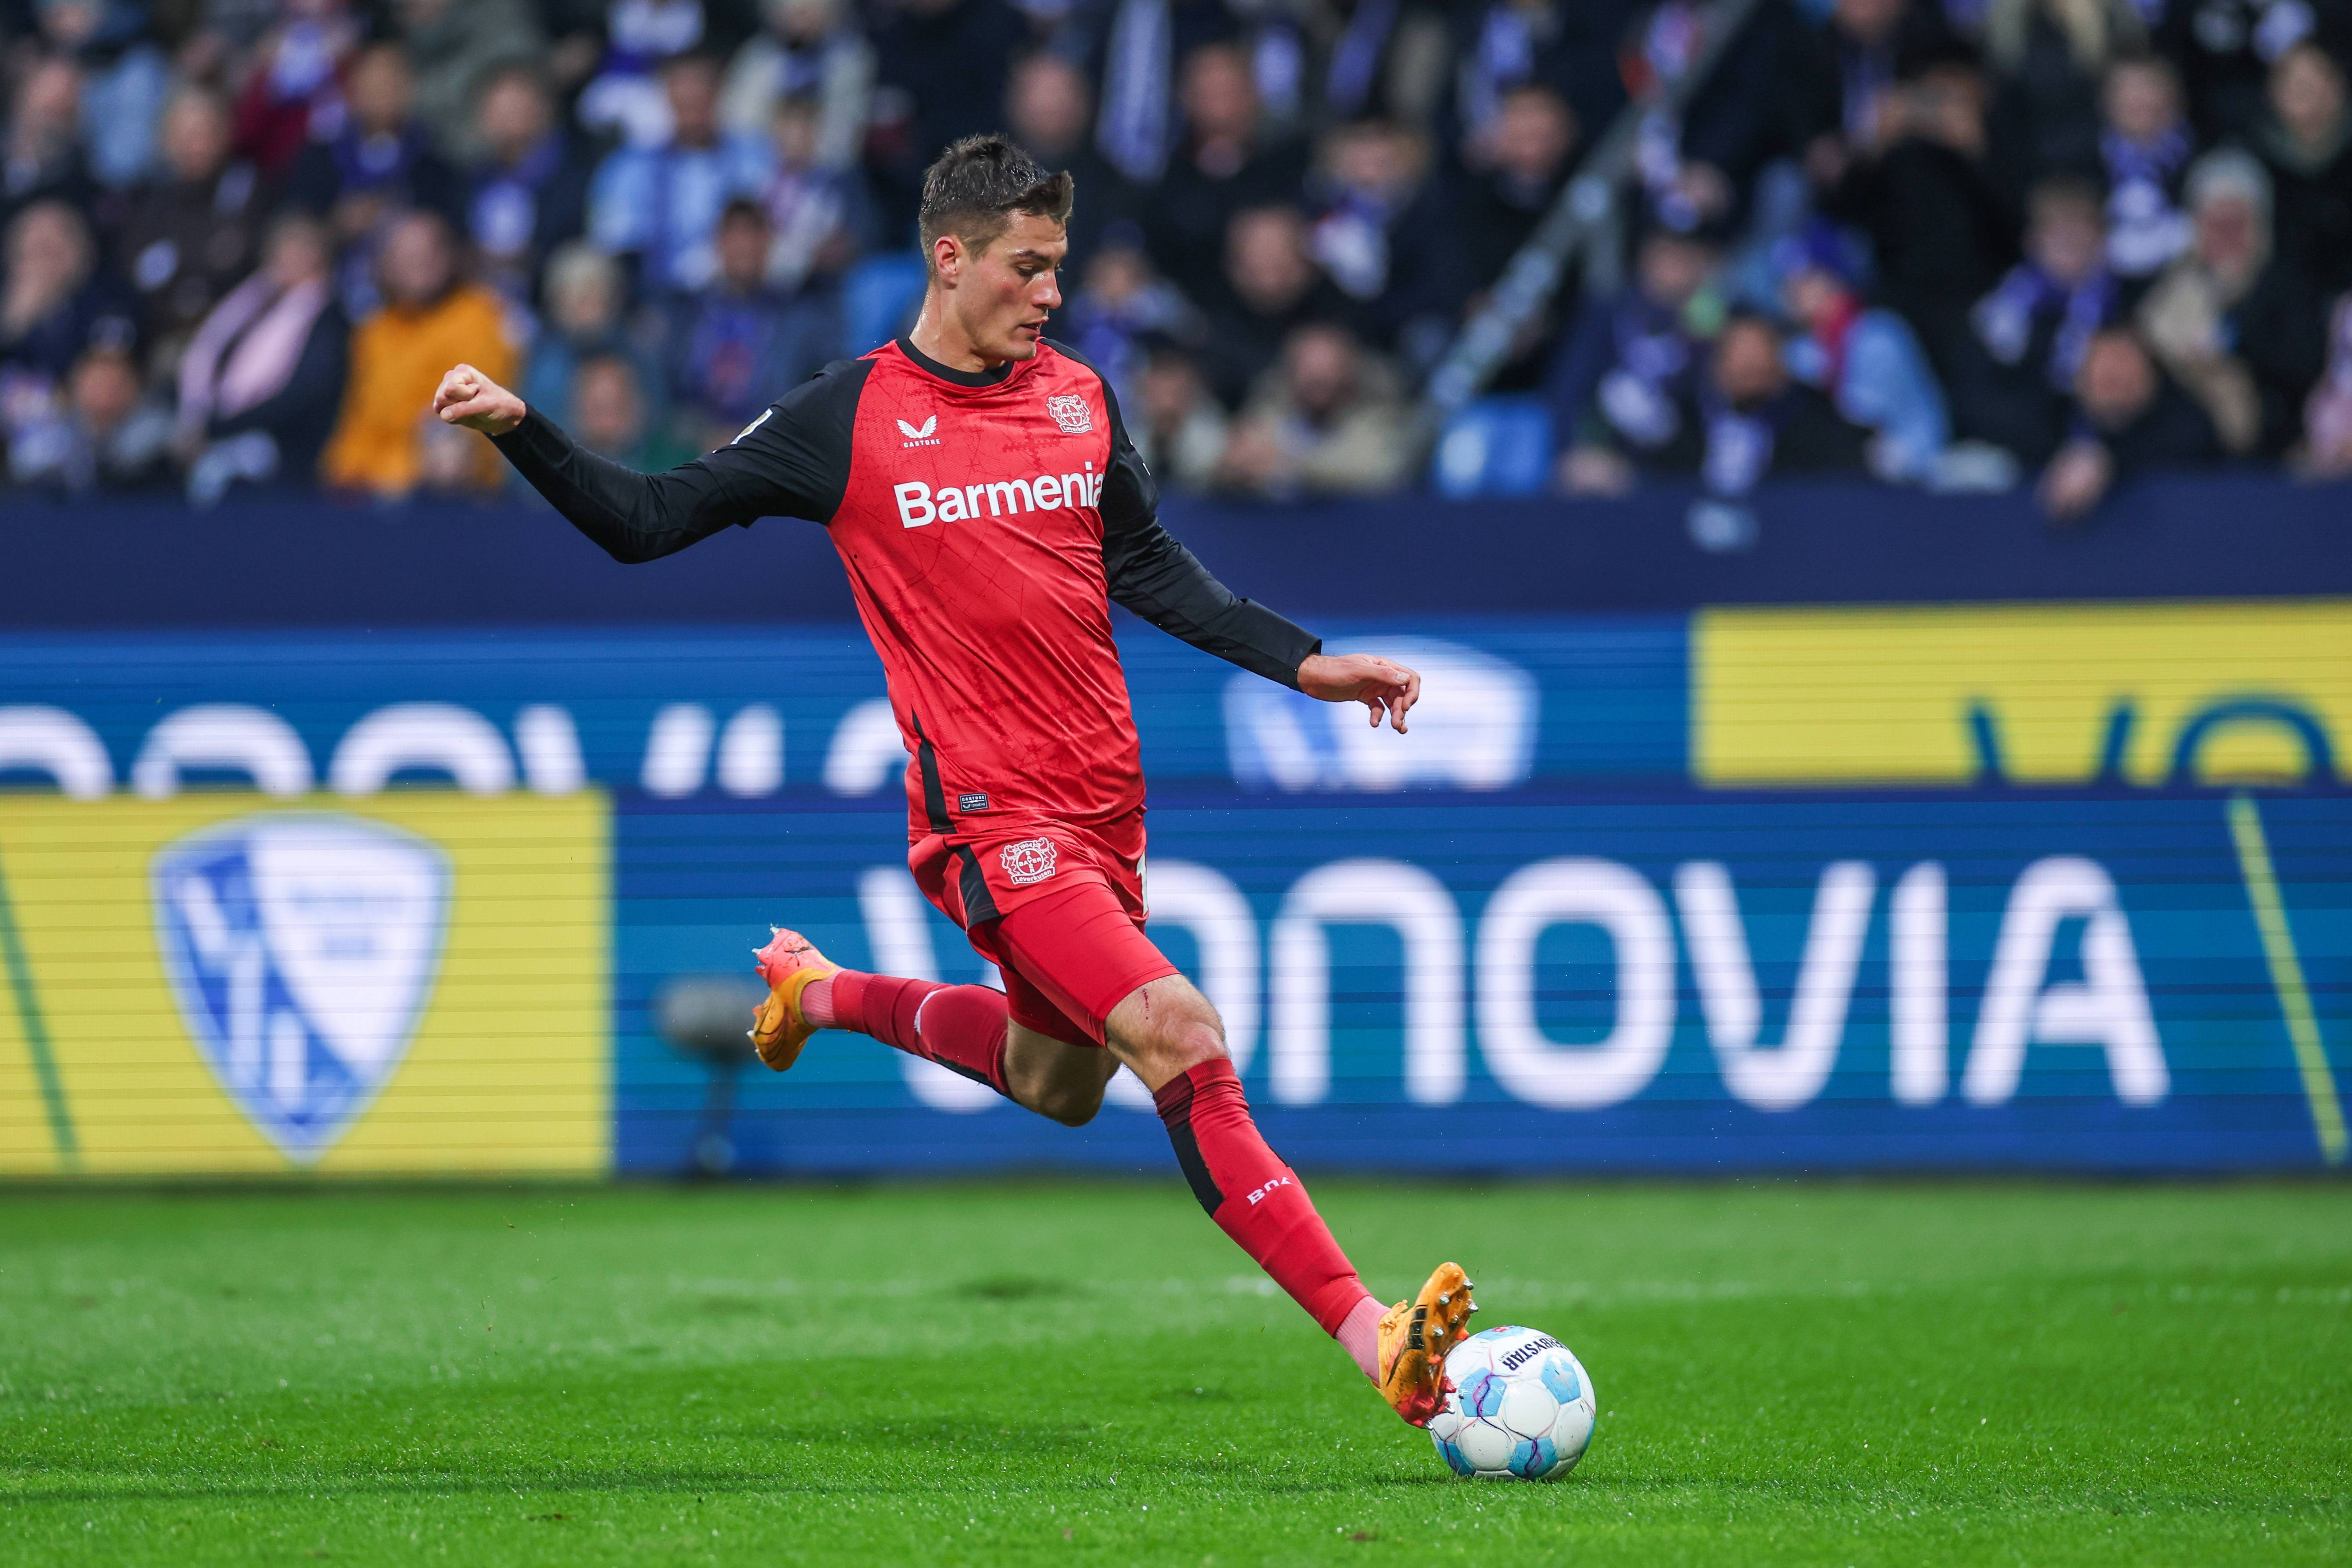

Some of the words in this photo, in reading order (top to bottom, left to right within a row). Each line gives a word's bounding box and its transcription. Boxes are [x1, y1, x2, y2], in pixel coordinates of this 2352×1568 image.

[904, 439, 940, 448] CASTORE
[893, 461, 1105, 529] Barmenia
[1019, 857, 1041, 867] BAYER
[1015, 870, 1052, 882] Leverkusen
